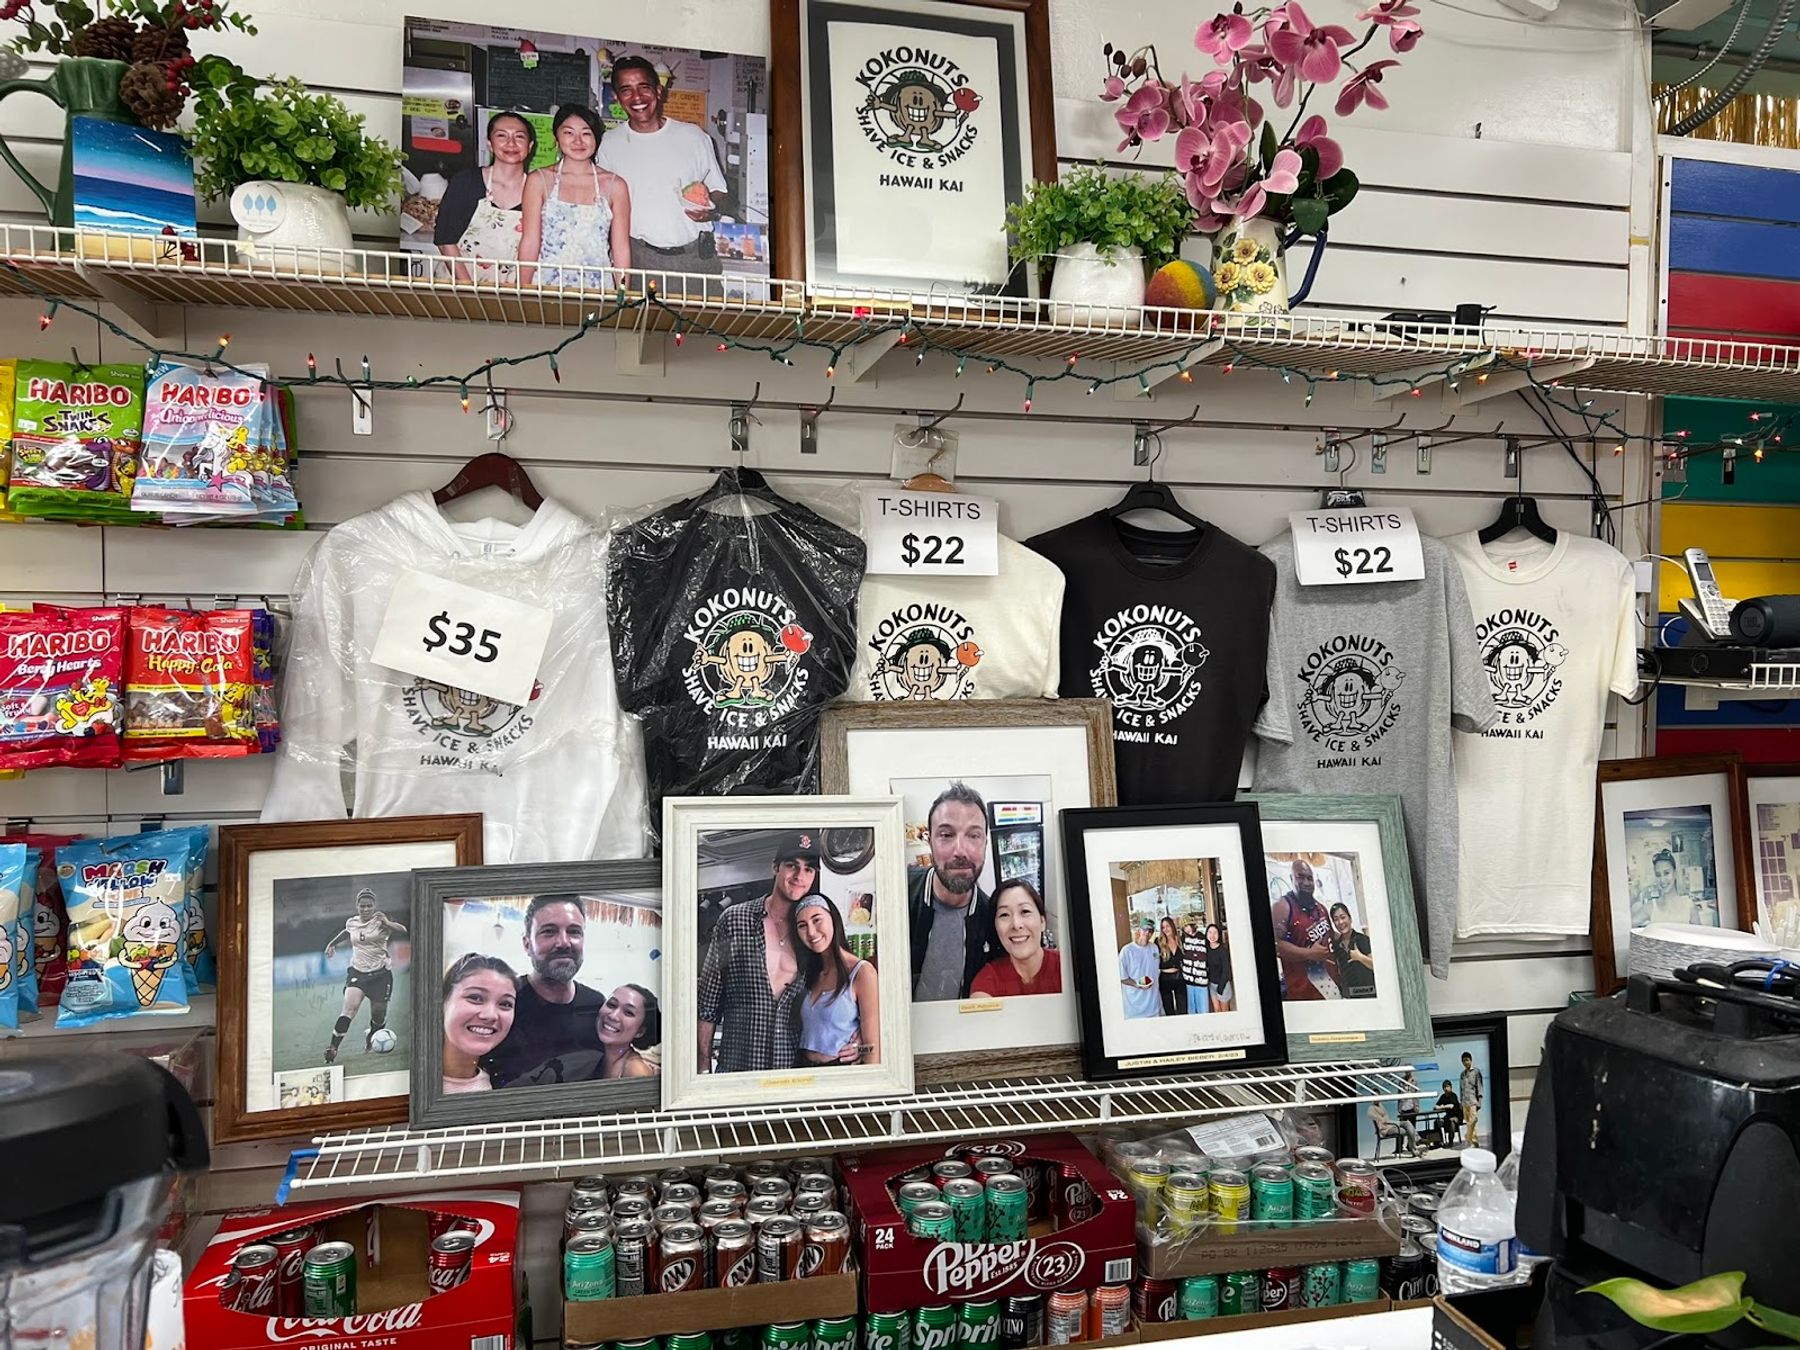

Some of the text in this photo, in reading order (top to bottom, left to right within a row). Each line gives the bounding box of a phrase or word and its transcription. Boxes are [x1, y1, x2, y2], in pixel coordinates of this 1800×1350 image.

[855, 46, 969, 88] KOKONUTS
[856, 106, 978, 170] SHAVE ICE & SNACKS
[879, 174, 963, 192] HAWAII KAI
[152, 363, 169, 379] NEW
[29, 378, 132, 408] HARIBO
[160, 382, 252, 408] HARIBO
[58, 410, 94, 421] TWIN
[877, 498, 981, 520] T-SHIRTS
[1306, 514, 1402, 533] T-SHIRTS
[901, 533, 965, 568] $22
[1334, 546, 1394, 579] $22
[683, 587, 797, 644] KOKONUTS
[868, 603, 975, 651] KOKONUTS
[1093, 604, 1202, 650] KOKONUTS
[1475, 608, 1560, 645] OKONUTS
[8, 628, 111, 658] HARIBO
[142, 628, 240, 655] HARIBO
[422, 611, 502, 663] $35
[57, 658, 102, 673] Hearts
[1297, 634, 1394, 683] KOKONUTS
[682, 667, 809, 728] SHAVE ICE & SNACKS
[867, 673, 887, 701] SHA
[1089, 669, 1202, 727] SHA ICE & SNACKS
[1515, 712, 1525, 724] &
[1528, 679, 1563, 721] SNACKS
[402, 686, 534, 754] SHAVE ICE & SNACKS
[1297, 702, 1401, 752] SHAVE ICE & SNACKS
[1525, 730, 1544, 739] KAI
[707, 734, 788, 750] HAWAII KAI
[1154, 732, 1178, 745] KAI
[420, 755, 472, 769] HAWAII
[1317, 757, 1382, 768] HAWAII KAI
[875, 1228, 895, 1244] 24
[1442, 1229, 1480, 1249] KIRKLAND
[936, 1239, 1028, 1296] Pepper
[1042, 1255, 1067, 1278] 23
[266, 1302, 424, 1343] CocaCola
[360, 1337, 397, 1348] TASTE
